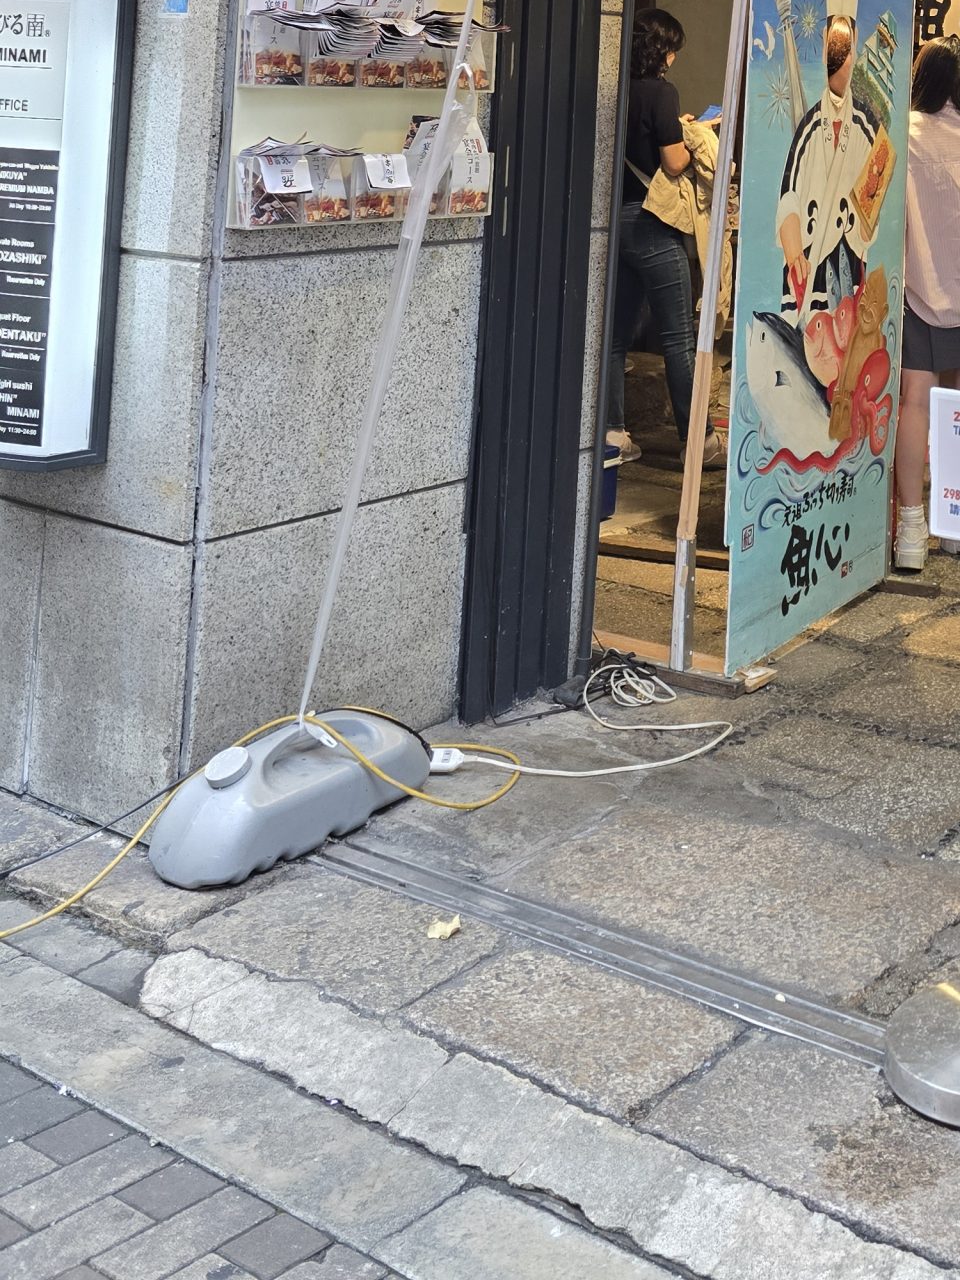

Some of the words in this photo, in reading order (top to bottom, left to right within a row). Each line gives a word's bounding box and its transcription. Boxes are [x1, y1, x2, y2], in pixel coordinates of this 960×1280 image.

[0, 47, 47, 63] INAMI
[27, 185, 54, 195] NAMBA
[11, 238, 35, 248] Rooms
[12, 313, 32, 323] Floor
[12, 381, 33, 391] sushi
[7, 406, 40, 419] MINAMI
[943, 488, 960, 501] 298
[780, 523, 851, 617] 魚心
